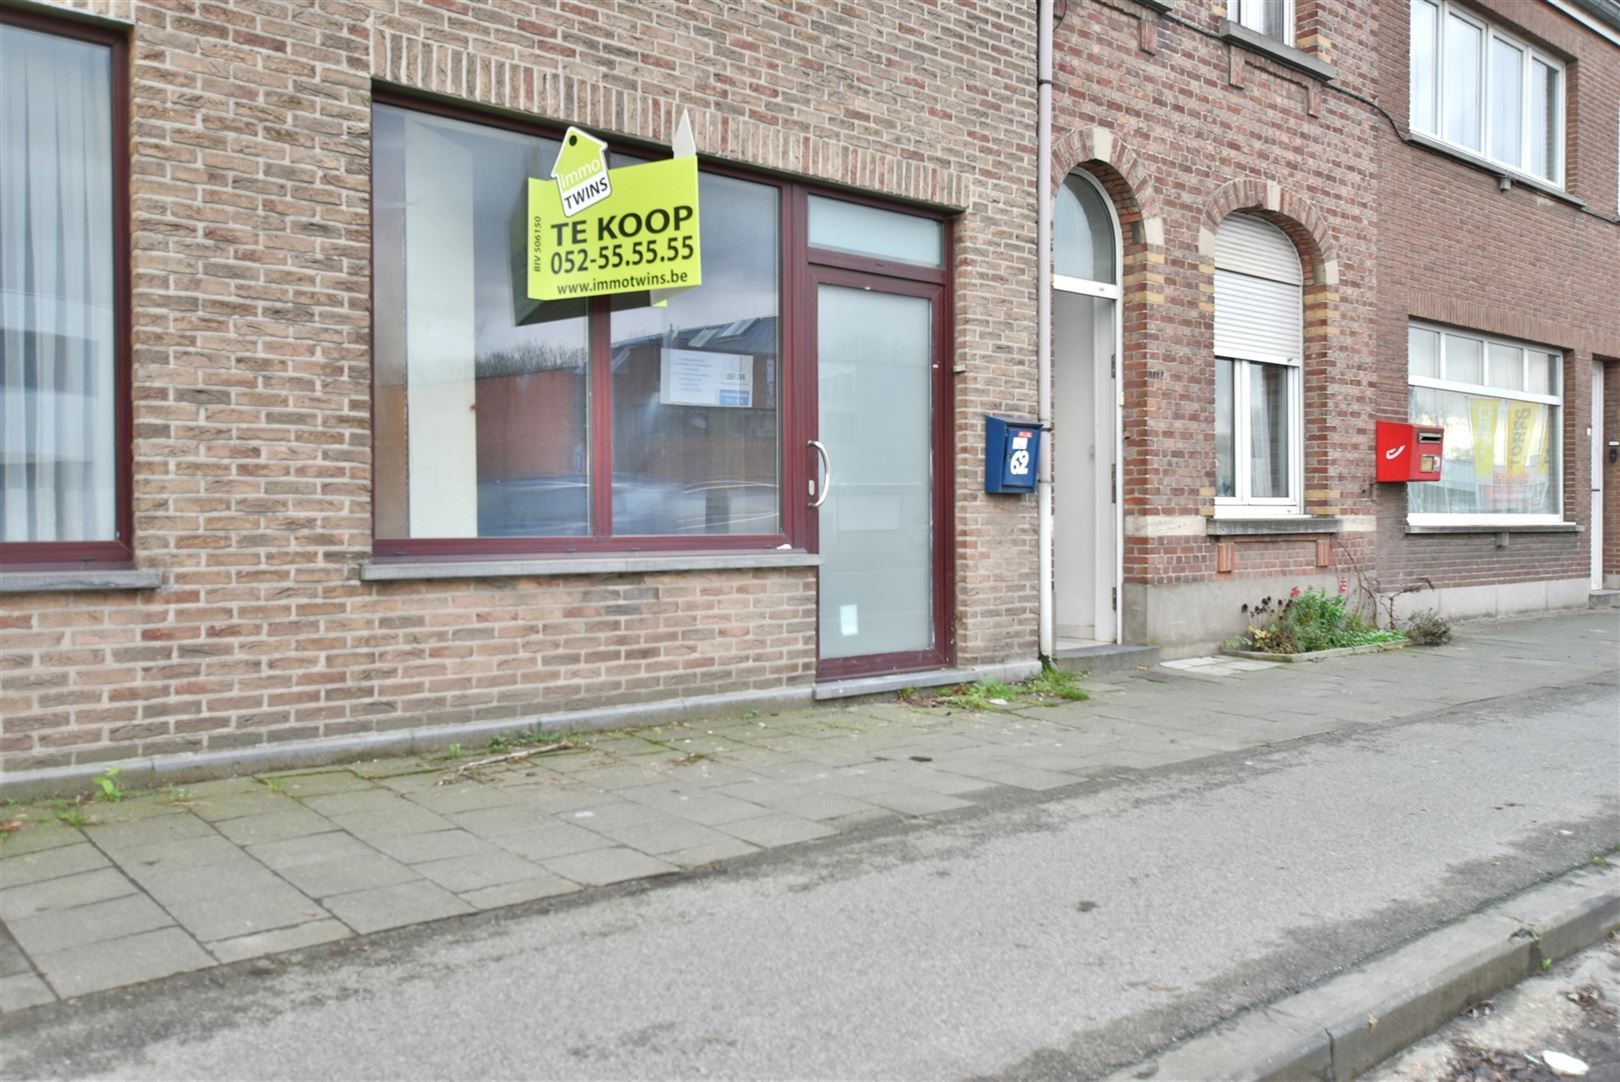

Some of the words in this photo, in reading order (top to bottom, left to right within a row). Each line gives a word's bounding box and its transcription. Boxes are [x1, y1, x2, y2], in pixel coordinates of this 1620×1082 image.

[560, 159, 601, 189] immo
[564, 176, 608, 209] TWINS
[533, 216, 541, 253] 506150
[551, 220, 588, 247] TE
[597, 205, 694, 241] KOOP
[533, 255, 541, 272] BIV
[551, 235, 694, 275] 052-55.55.55
[557, 269, 688, 295] www.immotwins.be
[1010, 450, 1030, 475] 62
